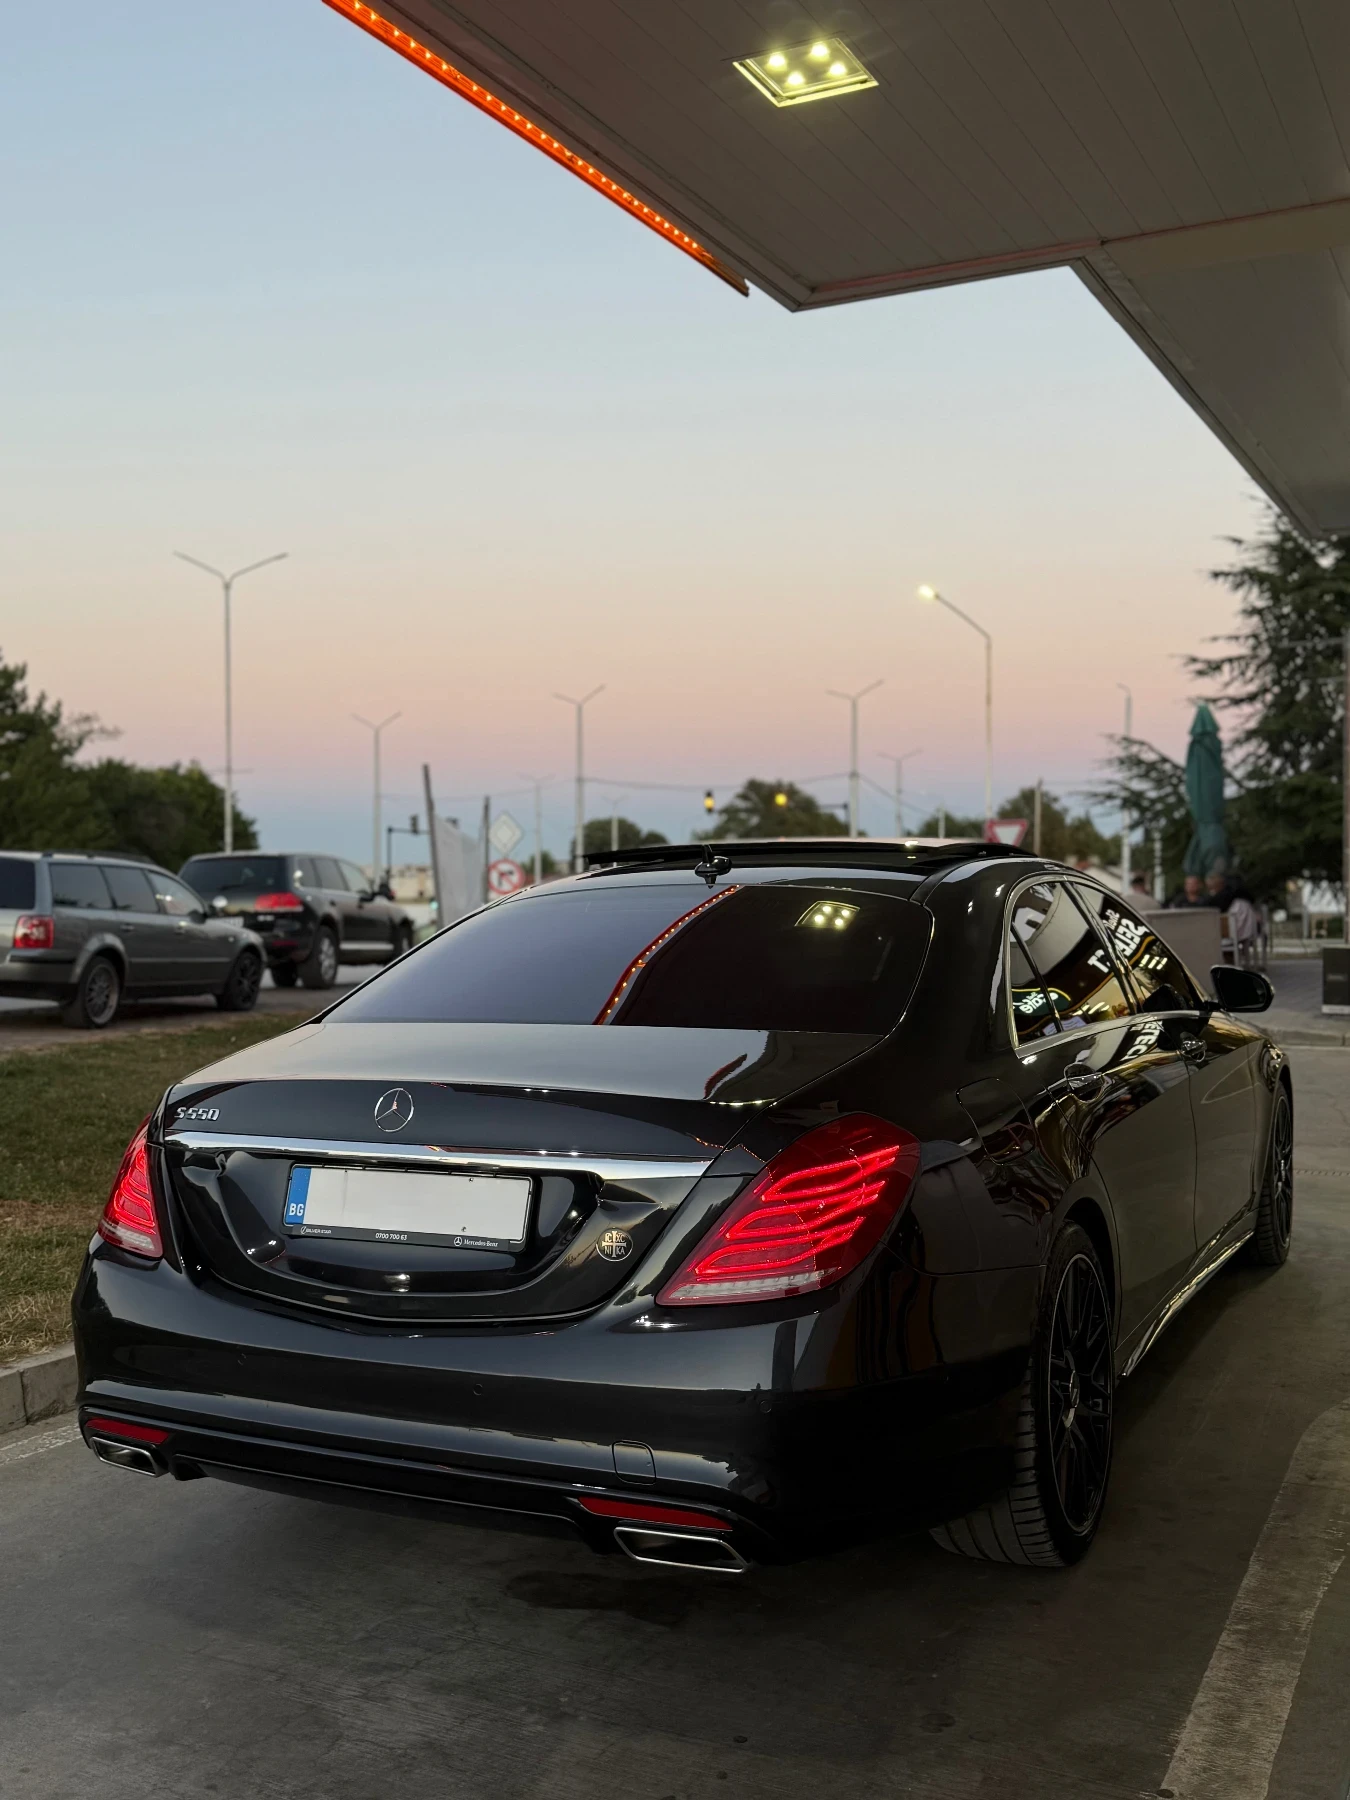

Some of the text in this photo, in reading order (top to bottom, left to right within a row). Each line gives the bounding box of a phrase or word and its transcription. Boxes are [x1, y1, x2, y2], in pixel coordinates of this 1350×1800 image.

[289, 1203, 304, 1216] BG
[375, 1232, 389, 1240] 0700
[464, 1238, 498, 1248] Mercedes-Benz
